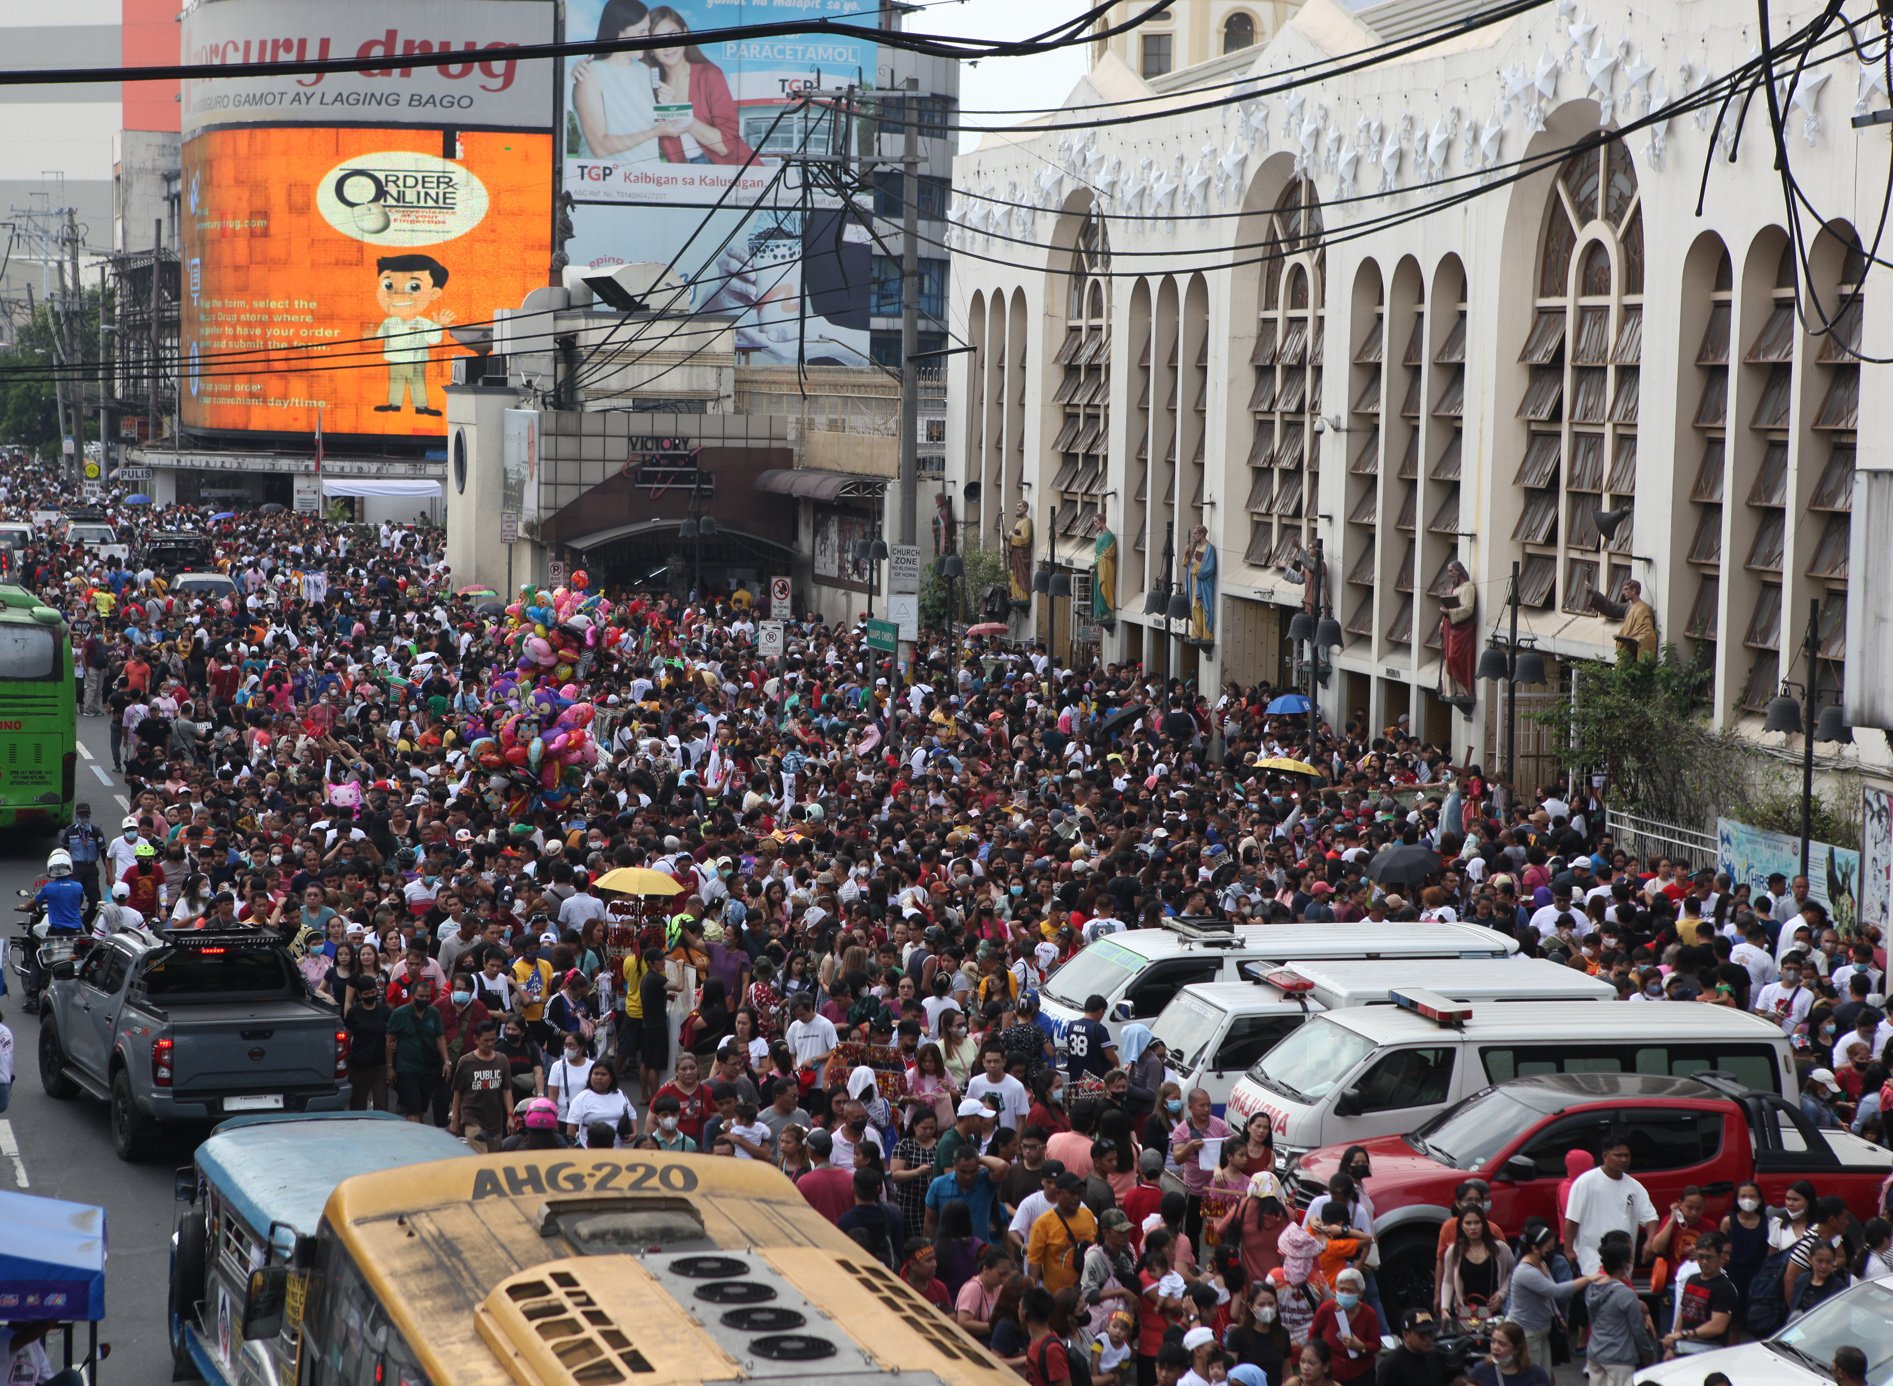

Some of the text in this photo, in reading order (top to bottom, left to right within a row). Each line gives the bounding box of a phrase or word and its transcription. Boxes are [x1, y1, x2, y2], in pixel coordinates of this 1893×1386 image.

[726, 43, 857, 62] PARACETAMOL
[355, 29, 519, 93] drug
[233, 92, 287, 107] GAMOT
[290, 91, 316, 102] AY
[319, 91, 401, 107] LAGING
[408, 93, 474, 109] BAGO
[577, 165, 613, 182] TGP
[623, 172, 678, 187] Kaibigan
[682, 178, 695, 186] sa
[252, 299, 290, 309] select
[294, 299, 318, 309] the
[240, 313, 268, 321] store
[273, 313, 314, 322] where
[236, 326, 262, 336] have
[265, 327, 295, 338] your
[299, 327, 340, 337] order
[228, 338, 264, 349] submit
[267, 397, 331, 409] day/time.
[629, 436, 690, 451] VICTORY
[121, 470, 152, 479] PULIS
[892, 547, 920, 557] CHURCH
[894, 556, 917, 566] ZONE
[1069, 1033, 1088, 1057] 38
[473, 1069, 502, 1081] PUBLIC
